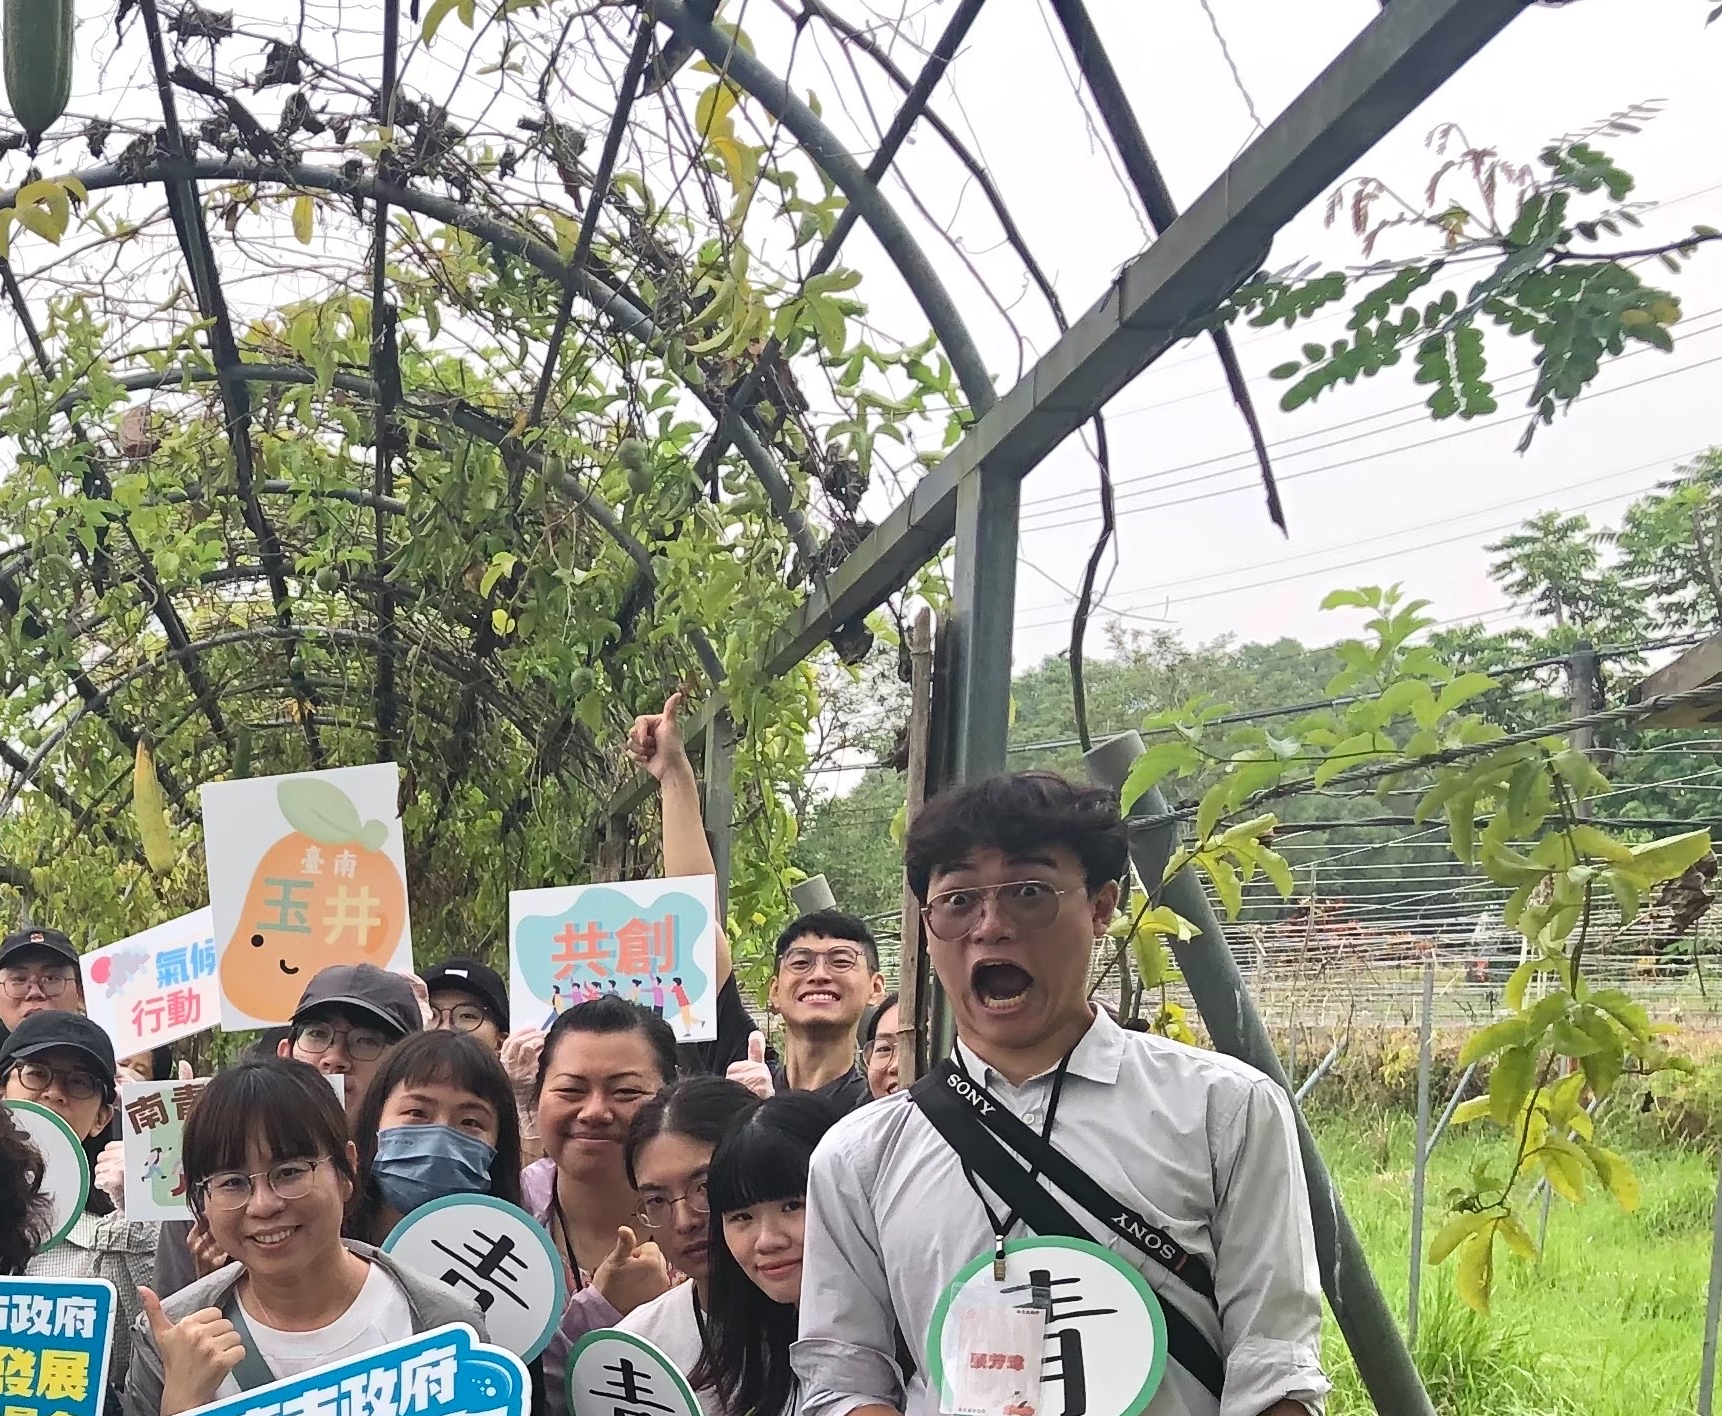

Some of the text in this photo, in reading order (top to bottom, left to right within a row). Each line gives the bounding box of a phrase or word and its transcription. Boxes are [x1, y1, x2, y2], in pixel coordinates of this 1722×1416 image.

[300, 846, 358, 880] 臺南
[255, 876, 381, 947] 玉井
[551, 914, 678, 980] 共創
[131, 987, 201, 1037] 行動
[947, 1073, 996, 1117] SONY
[1111, 1212, 1177, 1261] SONY
